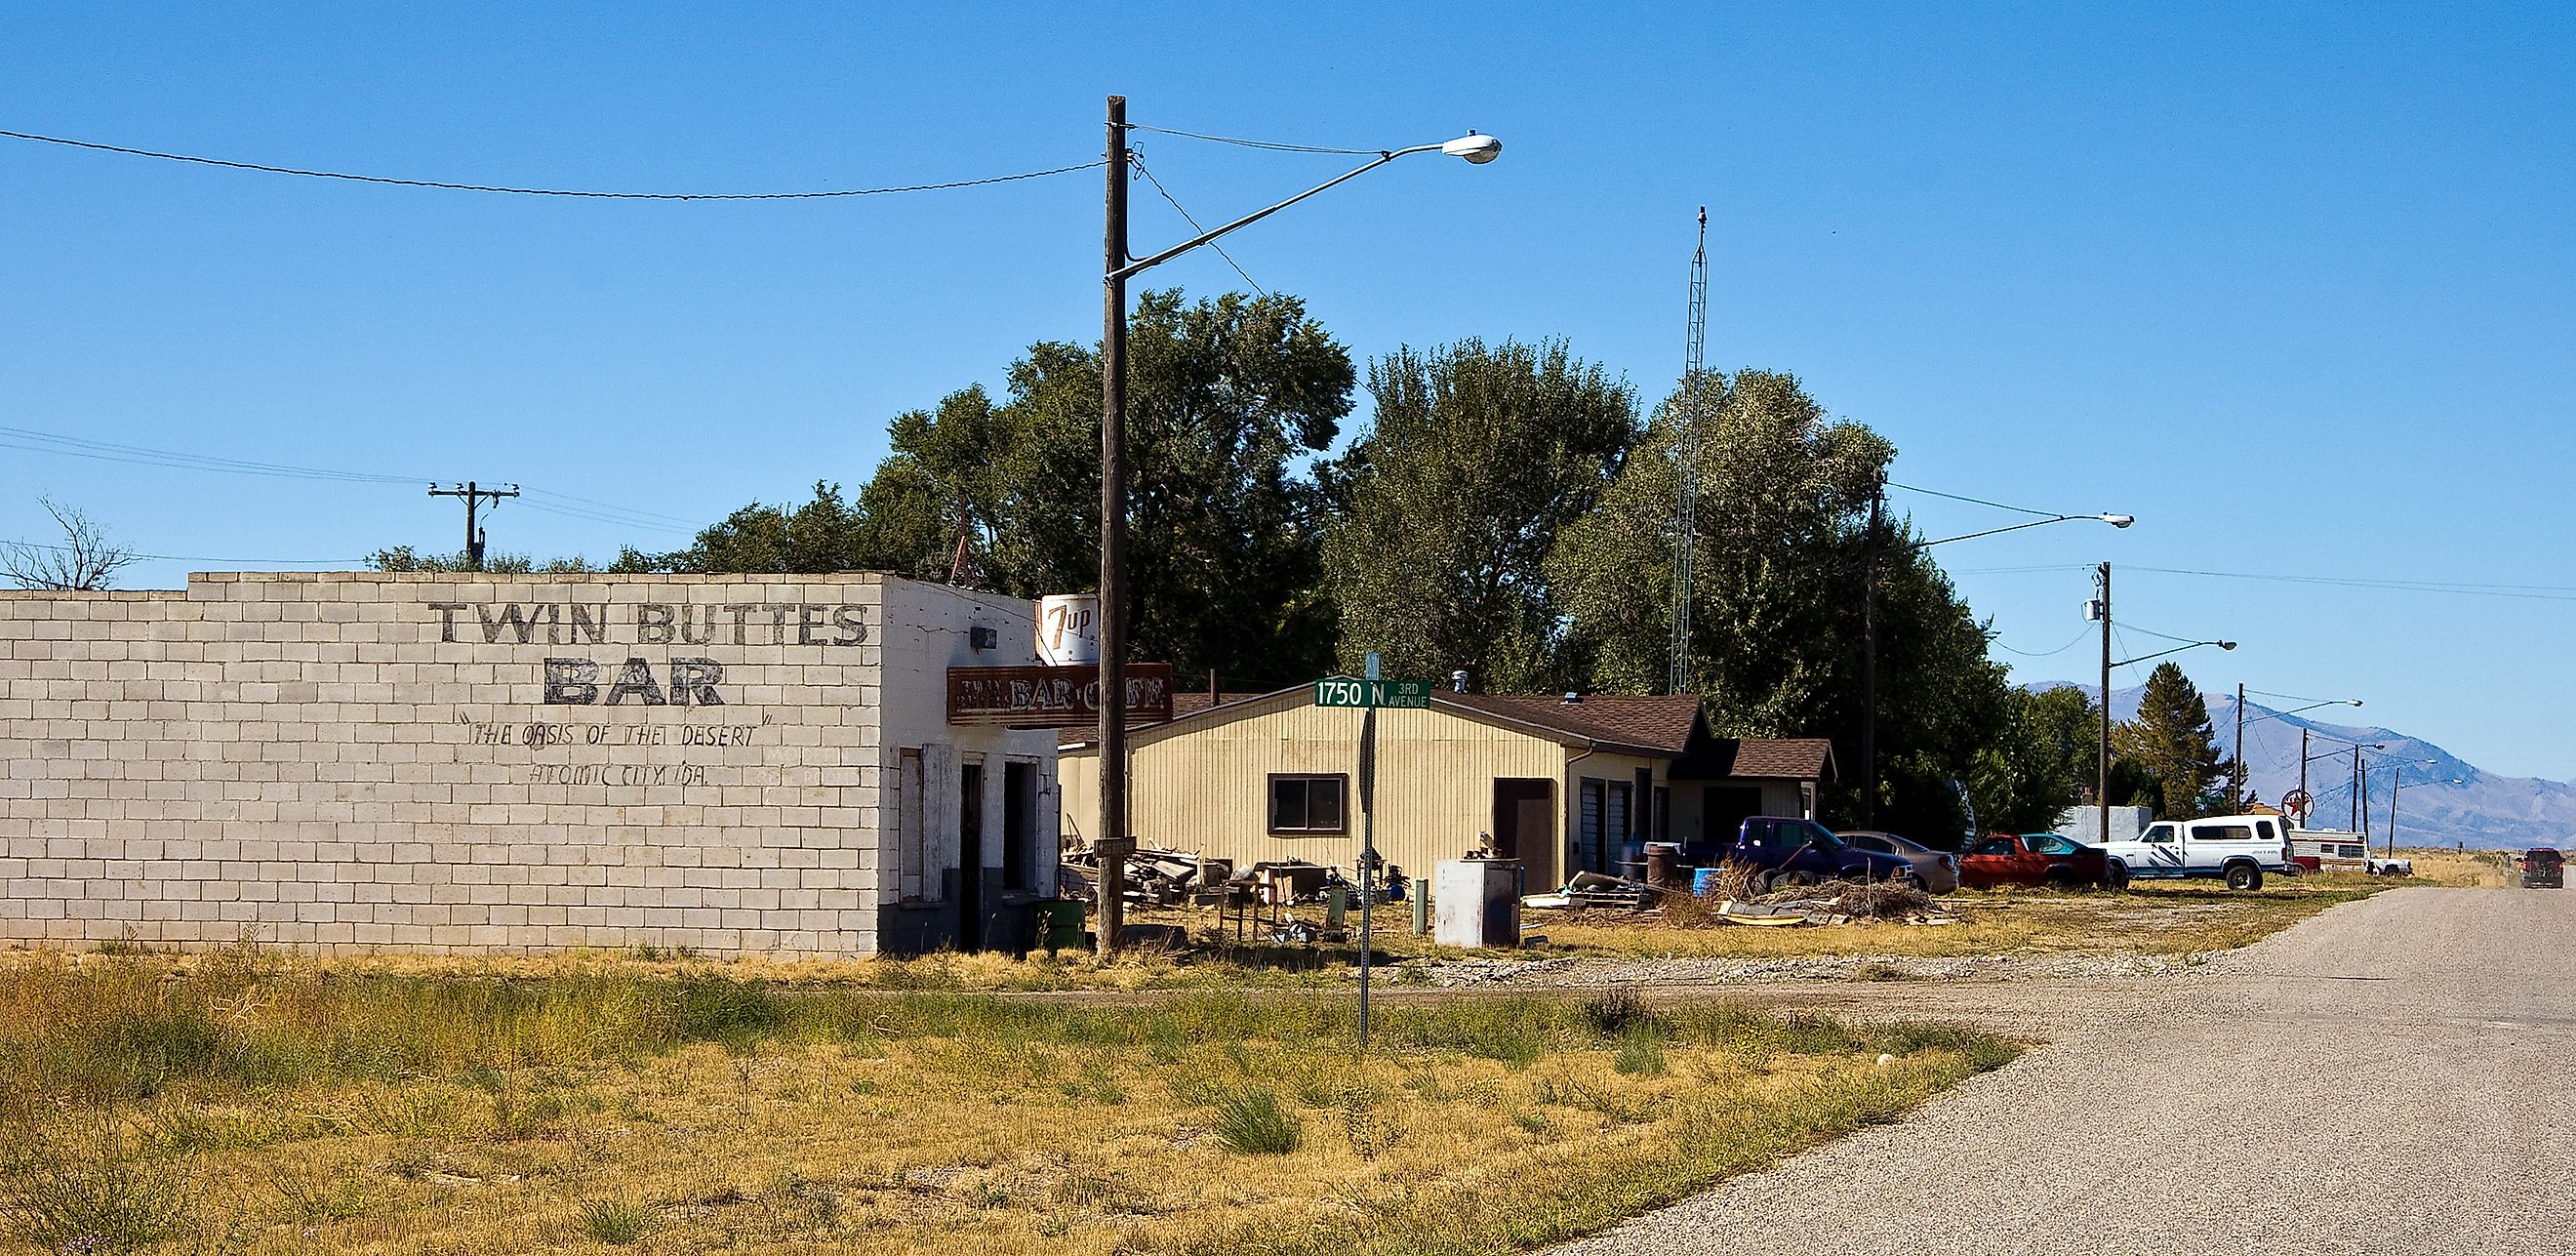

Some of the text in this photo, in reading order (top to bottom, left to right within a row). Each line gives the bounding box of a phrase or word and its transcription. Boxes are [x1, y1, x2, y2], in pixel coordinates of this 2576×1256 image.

[428, 603, 867, 645] TWIN BUTTES
[543, 657, 726, 705] BAR
[1398, 683, 1419, 695] 3RD
[1010, 677, 1165, 710] BAR CFE
[1318, 682, 1385, 706] 1750 N
[1389, 695, 1428, 708] AVENUE
[521, 724, 575, 746] OASIS
[587, 724, 612, 745] OF
[625, 725, 664, 746] THE
[529, 764, 612, 786] ATOMIC
